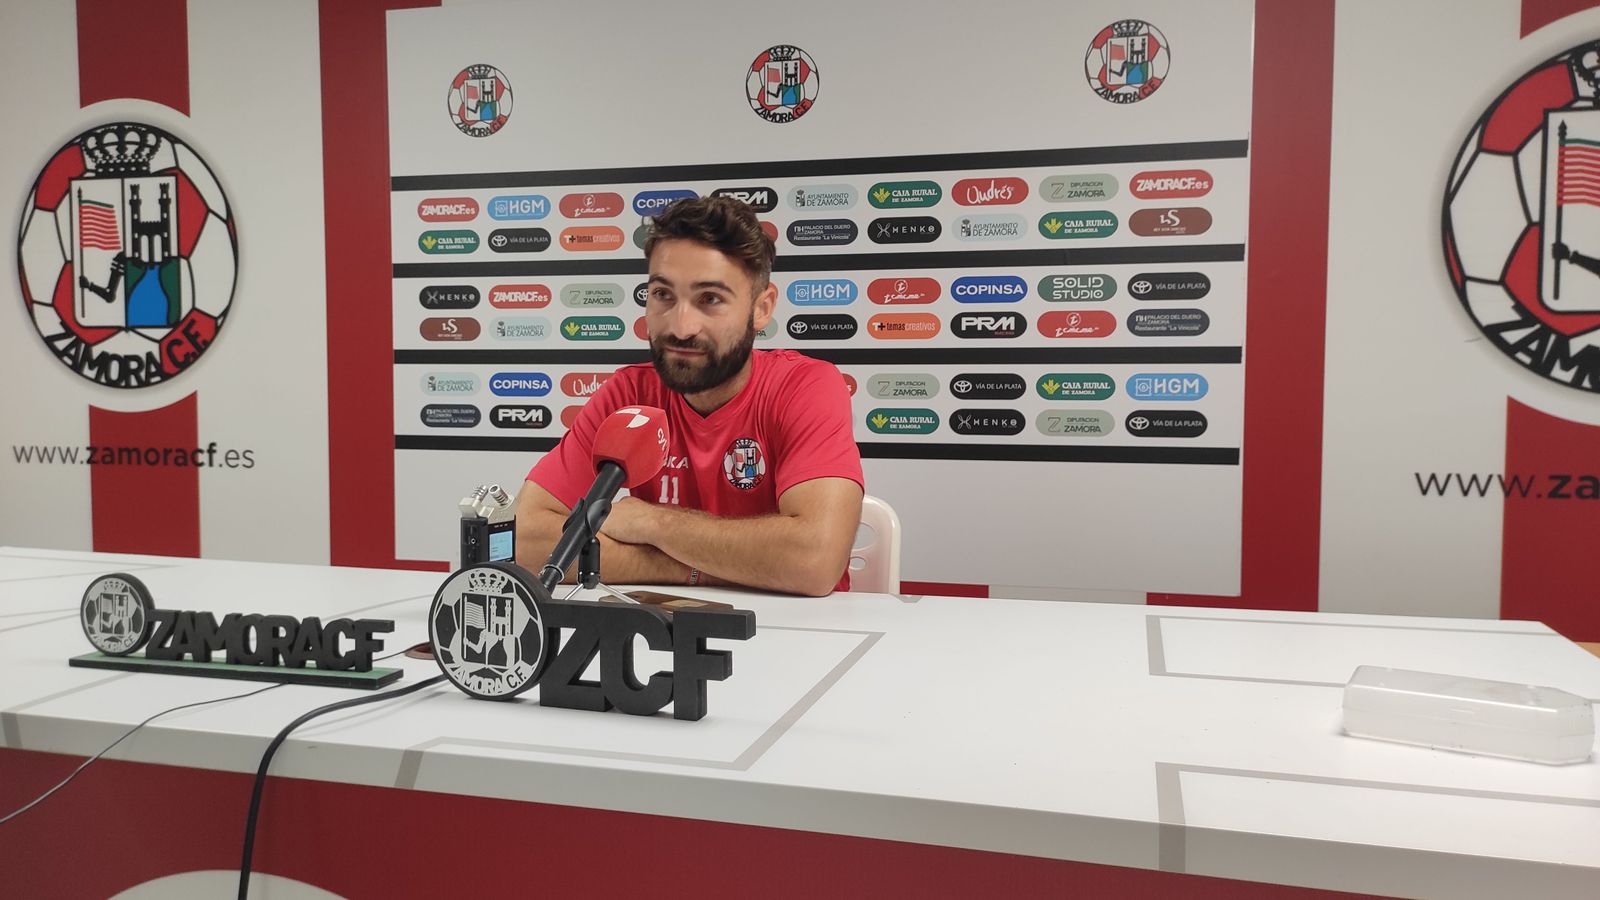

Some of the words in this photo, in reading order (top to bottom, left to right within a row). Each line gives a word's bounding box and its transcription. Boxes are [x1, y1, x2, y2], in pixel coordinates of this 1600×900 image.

[1136, 176, 1209, 192] ZAMORACF.es
[892, 189, 910, 197] CAJA
[911, 188, 938, 196] RURAL
[1067, 190, 1106, 198] ZAMORA
[509, 199, 544, 214] HGM
[636, 198, 673, 208] COPI
[817, 198, 849, 206] ZAMORA
[1064, 220, 1084, 228] CAJA
[1086, 219, 1113, 227] RURAL
[984, 228, 1018, 237] ZAMORA
[1053, 277, 1104, 289] SOLID
[811, 283, 851, 299] HGM
[955, 284, 1024, 296] COPINSA
[1053, 289, 1104, 300] STUDIO
[583, 297, 614, 305] ZAMORA
[961, 316, 1015, 331] PRM
[45, 320, 168, 387] ZAMORA
[492, 379, 549, 390] COPINSA
[1062, 382, 1082, 390] CAJA
[1083, 381, 1111, 389] RURAL
[1154, 378, 1200, 394] HGM
[893, 389, 928, 397] ZAMORA
[498, 408, 543, 422] PRM
[890, 416, 908, 424] CAJA
[909, 416, 935, 424] RURAL
[1064, 425, 1102, 433] ZAMORA
[12, 442, 255, 470] www.zamoracf.es
[658, 474, 680, 505] 11
[145, 608, 395, 672] ZAMORACF
[540, 599, 757, 722] ZCF
